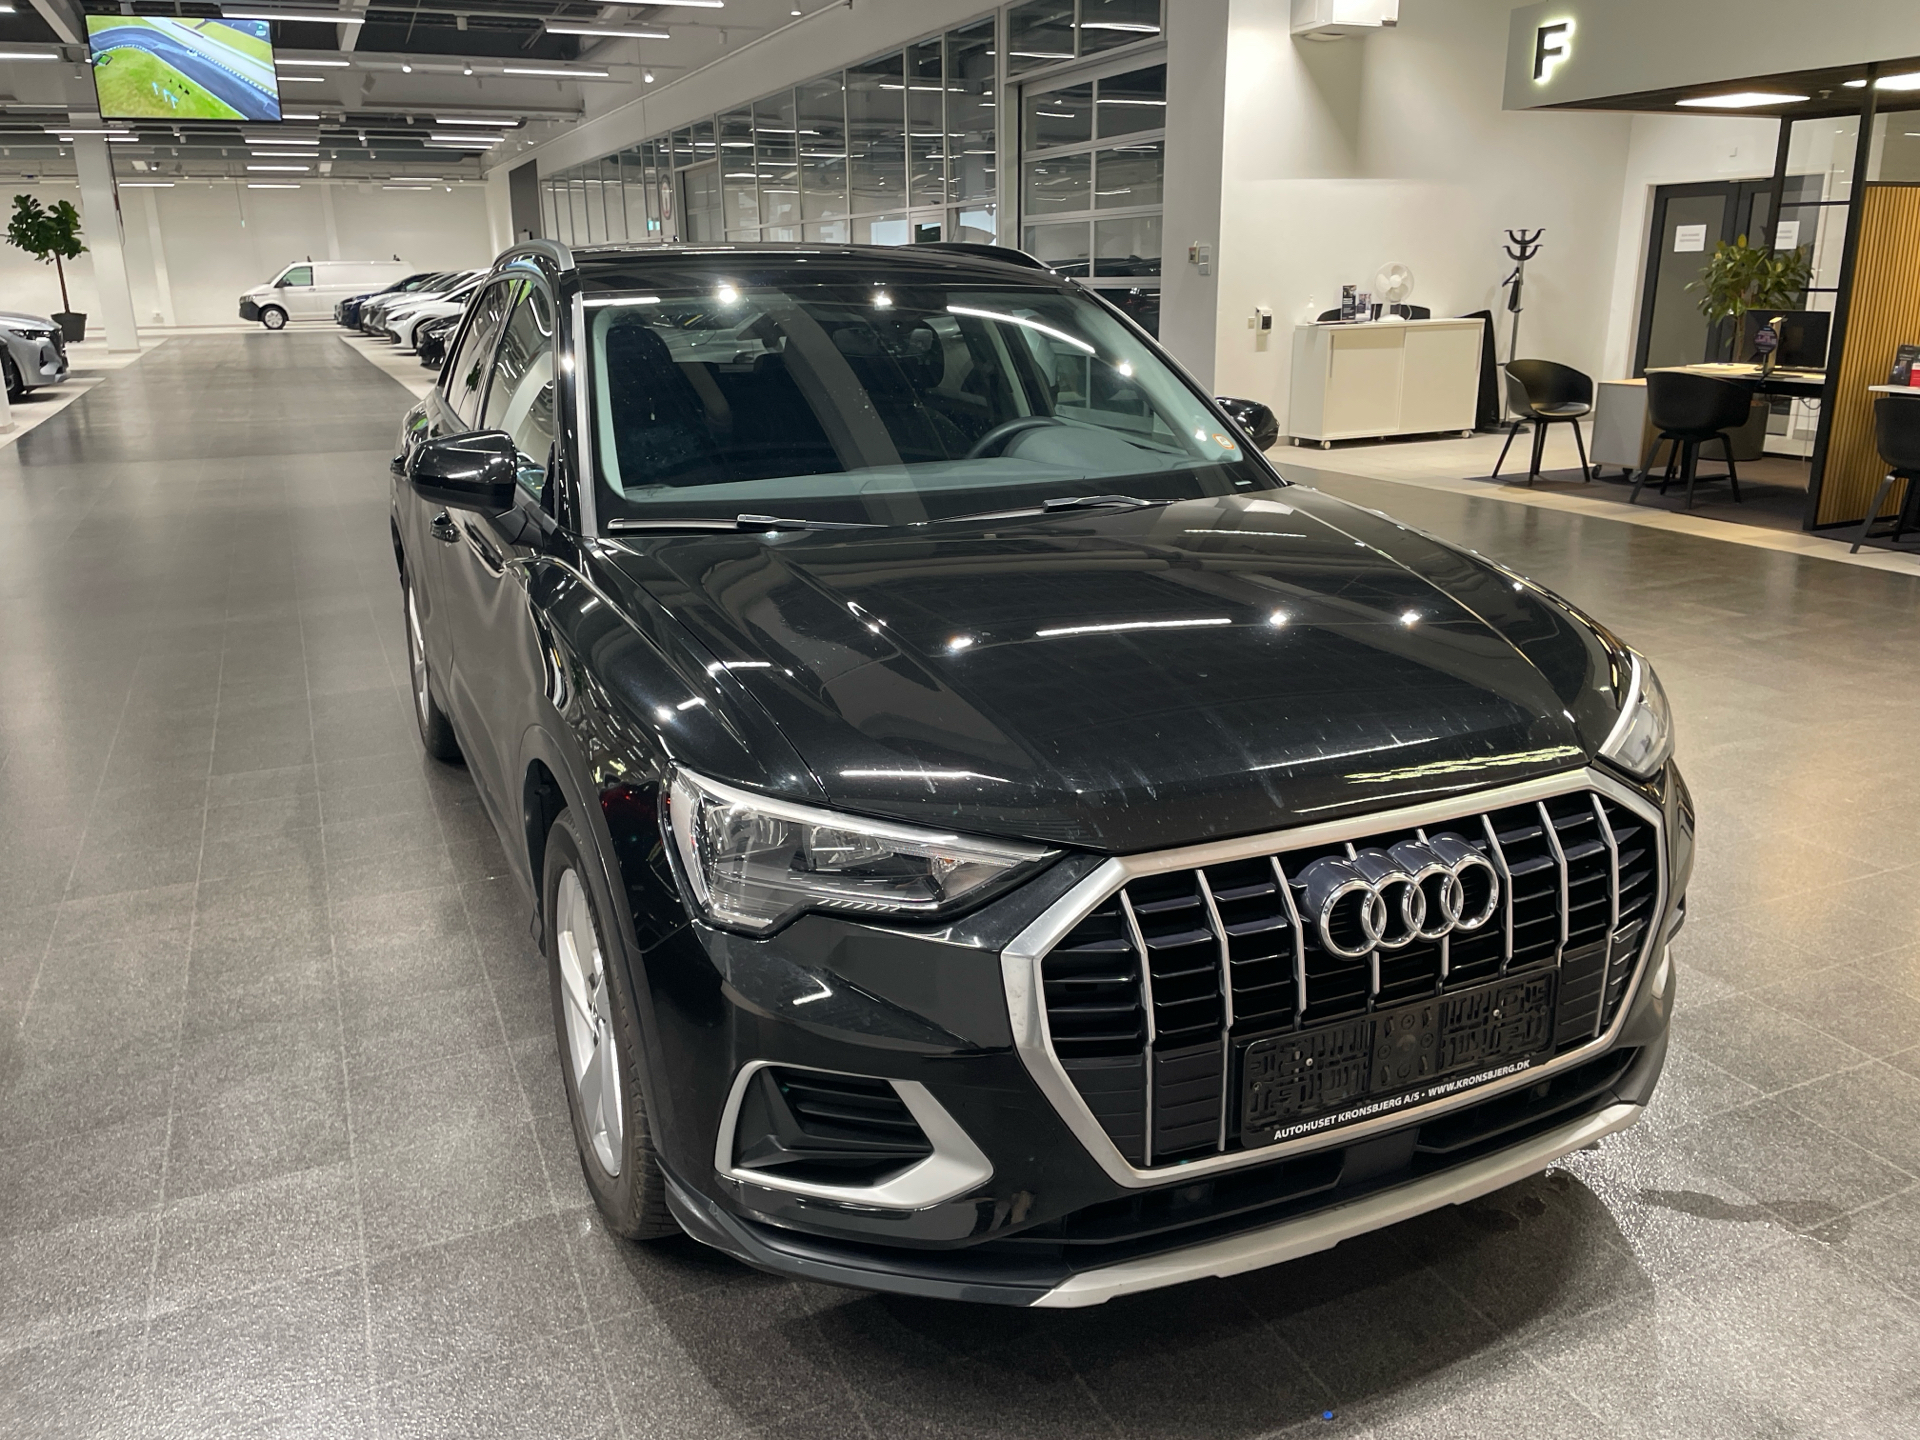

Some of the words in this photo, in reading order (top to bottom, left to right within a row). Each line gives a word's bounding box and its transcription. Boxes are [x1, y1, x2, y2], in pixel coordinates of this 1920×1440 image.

[1533, 21, 1570, 81] F
[1274, 1115, 1337, 1140] AUTOHUSET
[1338, 1096, 1402, 1123] KRONSBJERG
[1403, 1091, 1420, 1105] A/S
[1428, 1059, 1531, 1097] WWW.KRONSBJERG.DK
